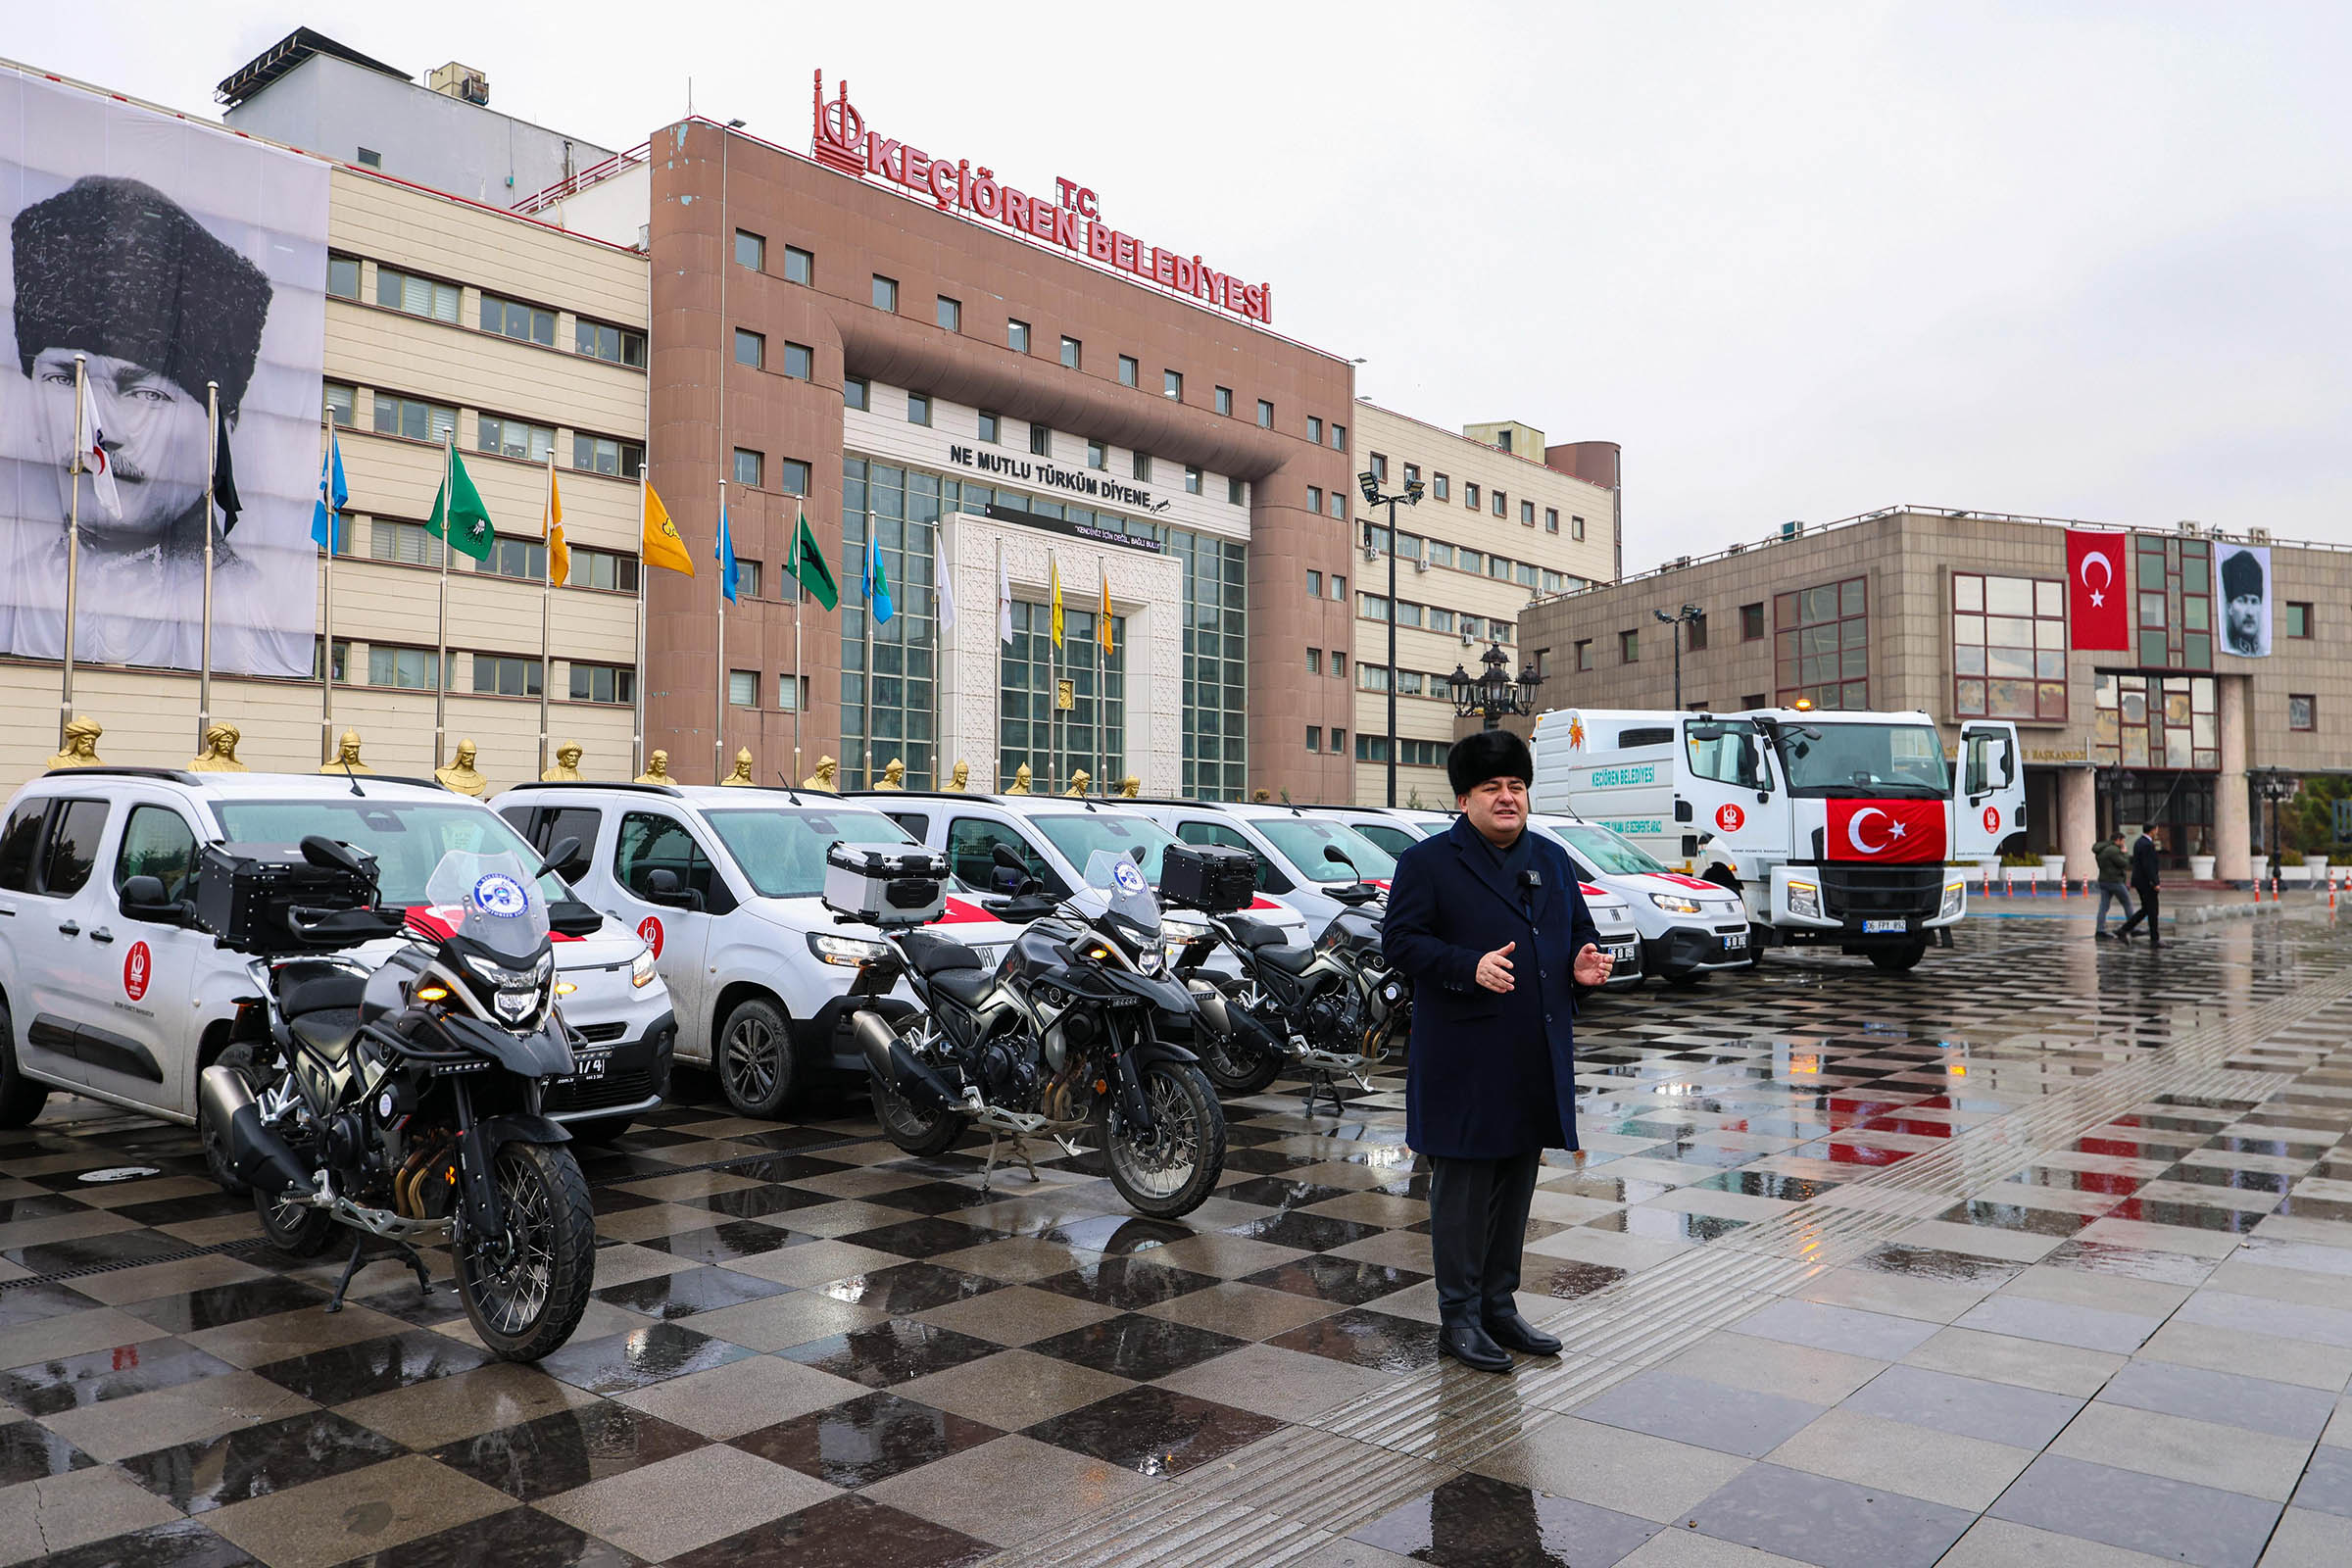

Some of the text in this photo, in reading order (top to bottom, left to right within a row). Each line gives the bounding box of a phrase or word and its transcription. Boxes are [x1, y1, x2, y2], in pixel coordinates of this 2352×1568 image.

[1055, 175, 1102, 221] T.C.
[867, 130, 1272, 324] KEÇİÖREN BELEDİYESİ
[951, 444, 973, 466] NE
[977, 452, 1031, 479] MUTLU
[1036, 464, 1098, 495] TÜRKÜM
[1101, 478, 1152, 508] DİYENE
[1592, 762, 1655, 788] KEÇİÖREN BELEDİYESİ
